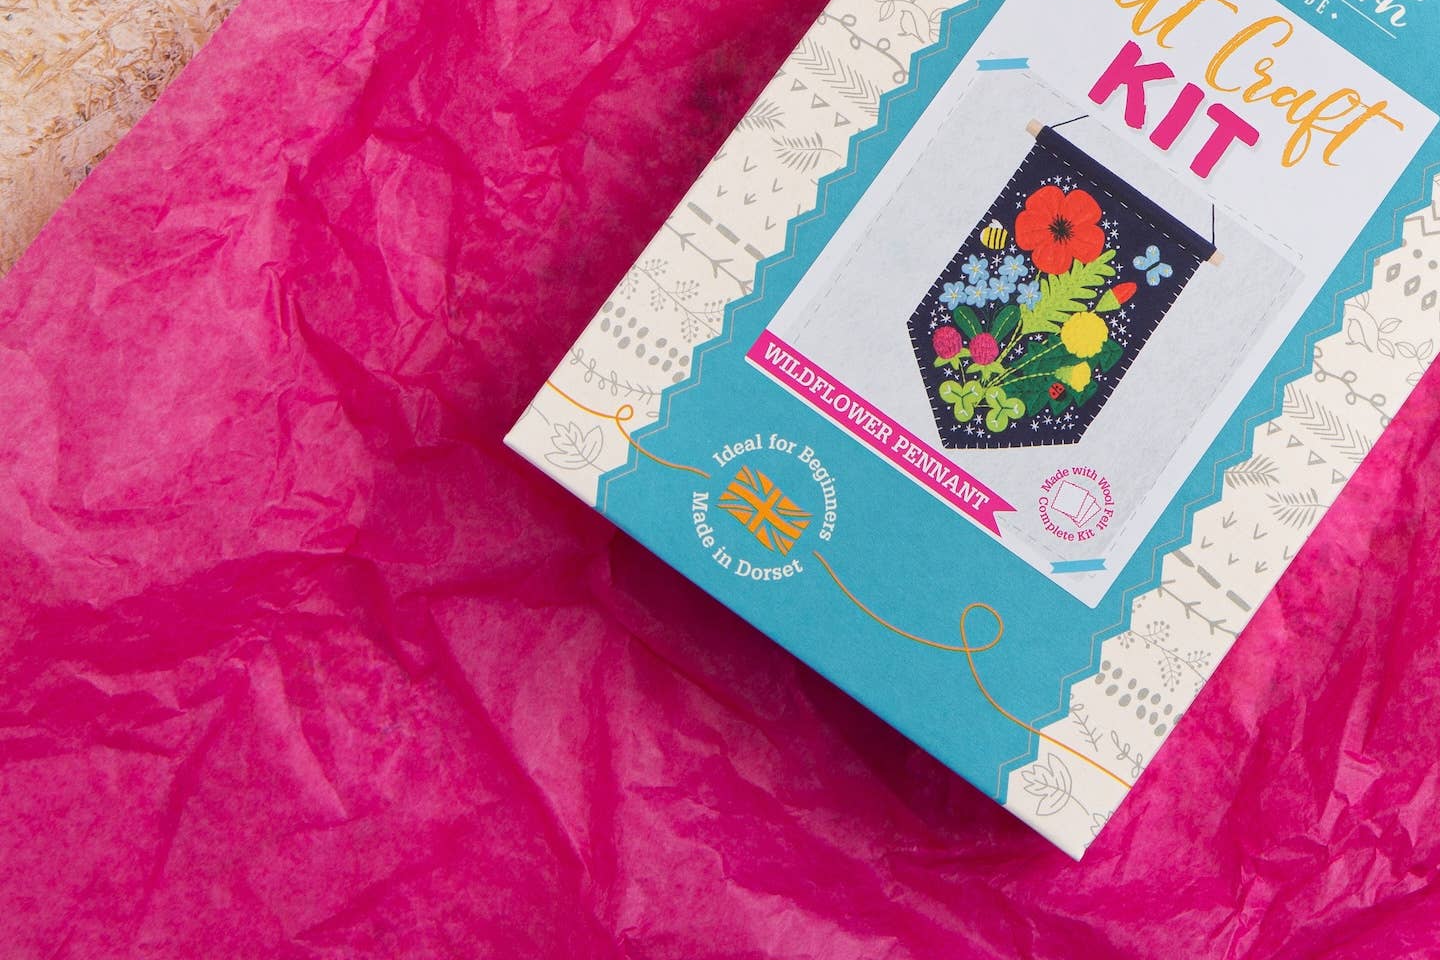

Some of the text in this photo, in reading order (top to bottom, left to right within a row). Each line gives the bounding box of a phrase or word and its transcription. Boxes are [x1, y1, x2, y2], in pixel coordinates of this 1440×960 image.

[1087, 39, 1260, 179] KIT
[1205, 15, 1405, 168] Craft
[764, 342, 990, 511] WILDFLOWER PENNANT
[692, 492, 803, 581] Made in Dorset
[712, 433, 838, 541] Ideal for Beginners
[1039, 496, 1095, 541] Complete Kit
[1041, 466, 1115, 530] Made with Wool Felt
